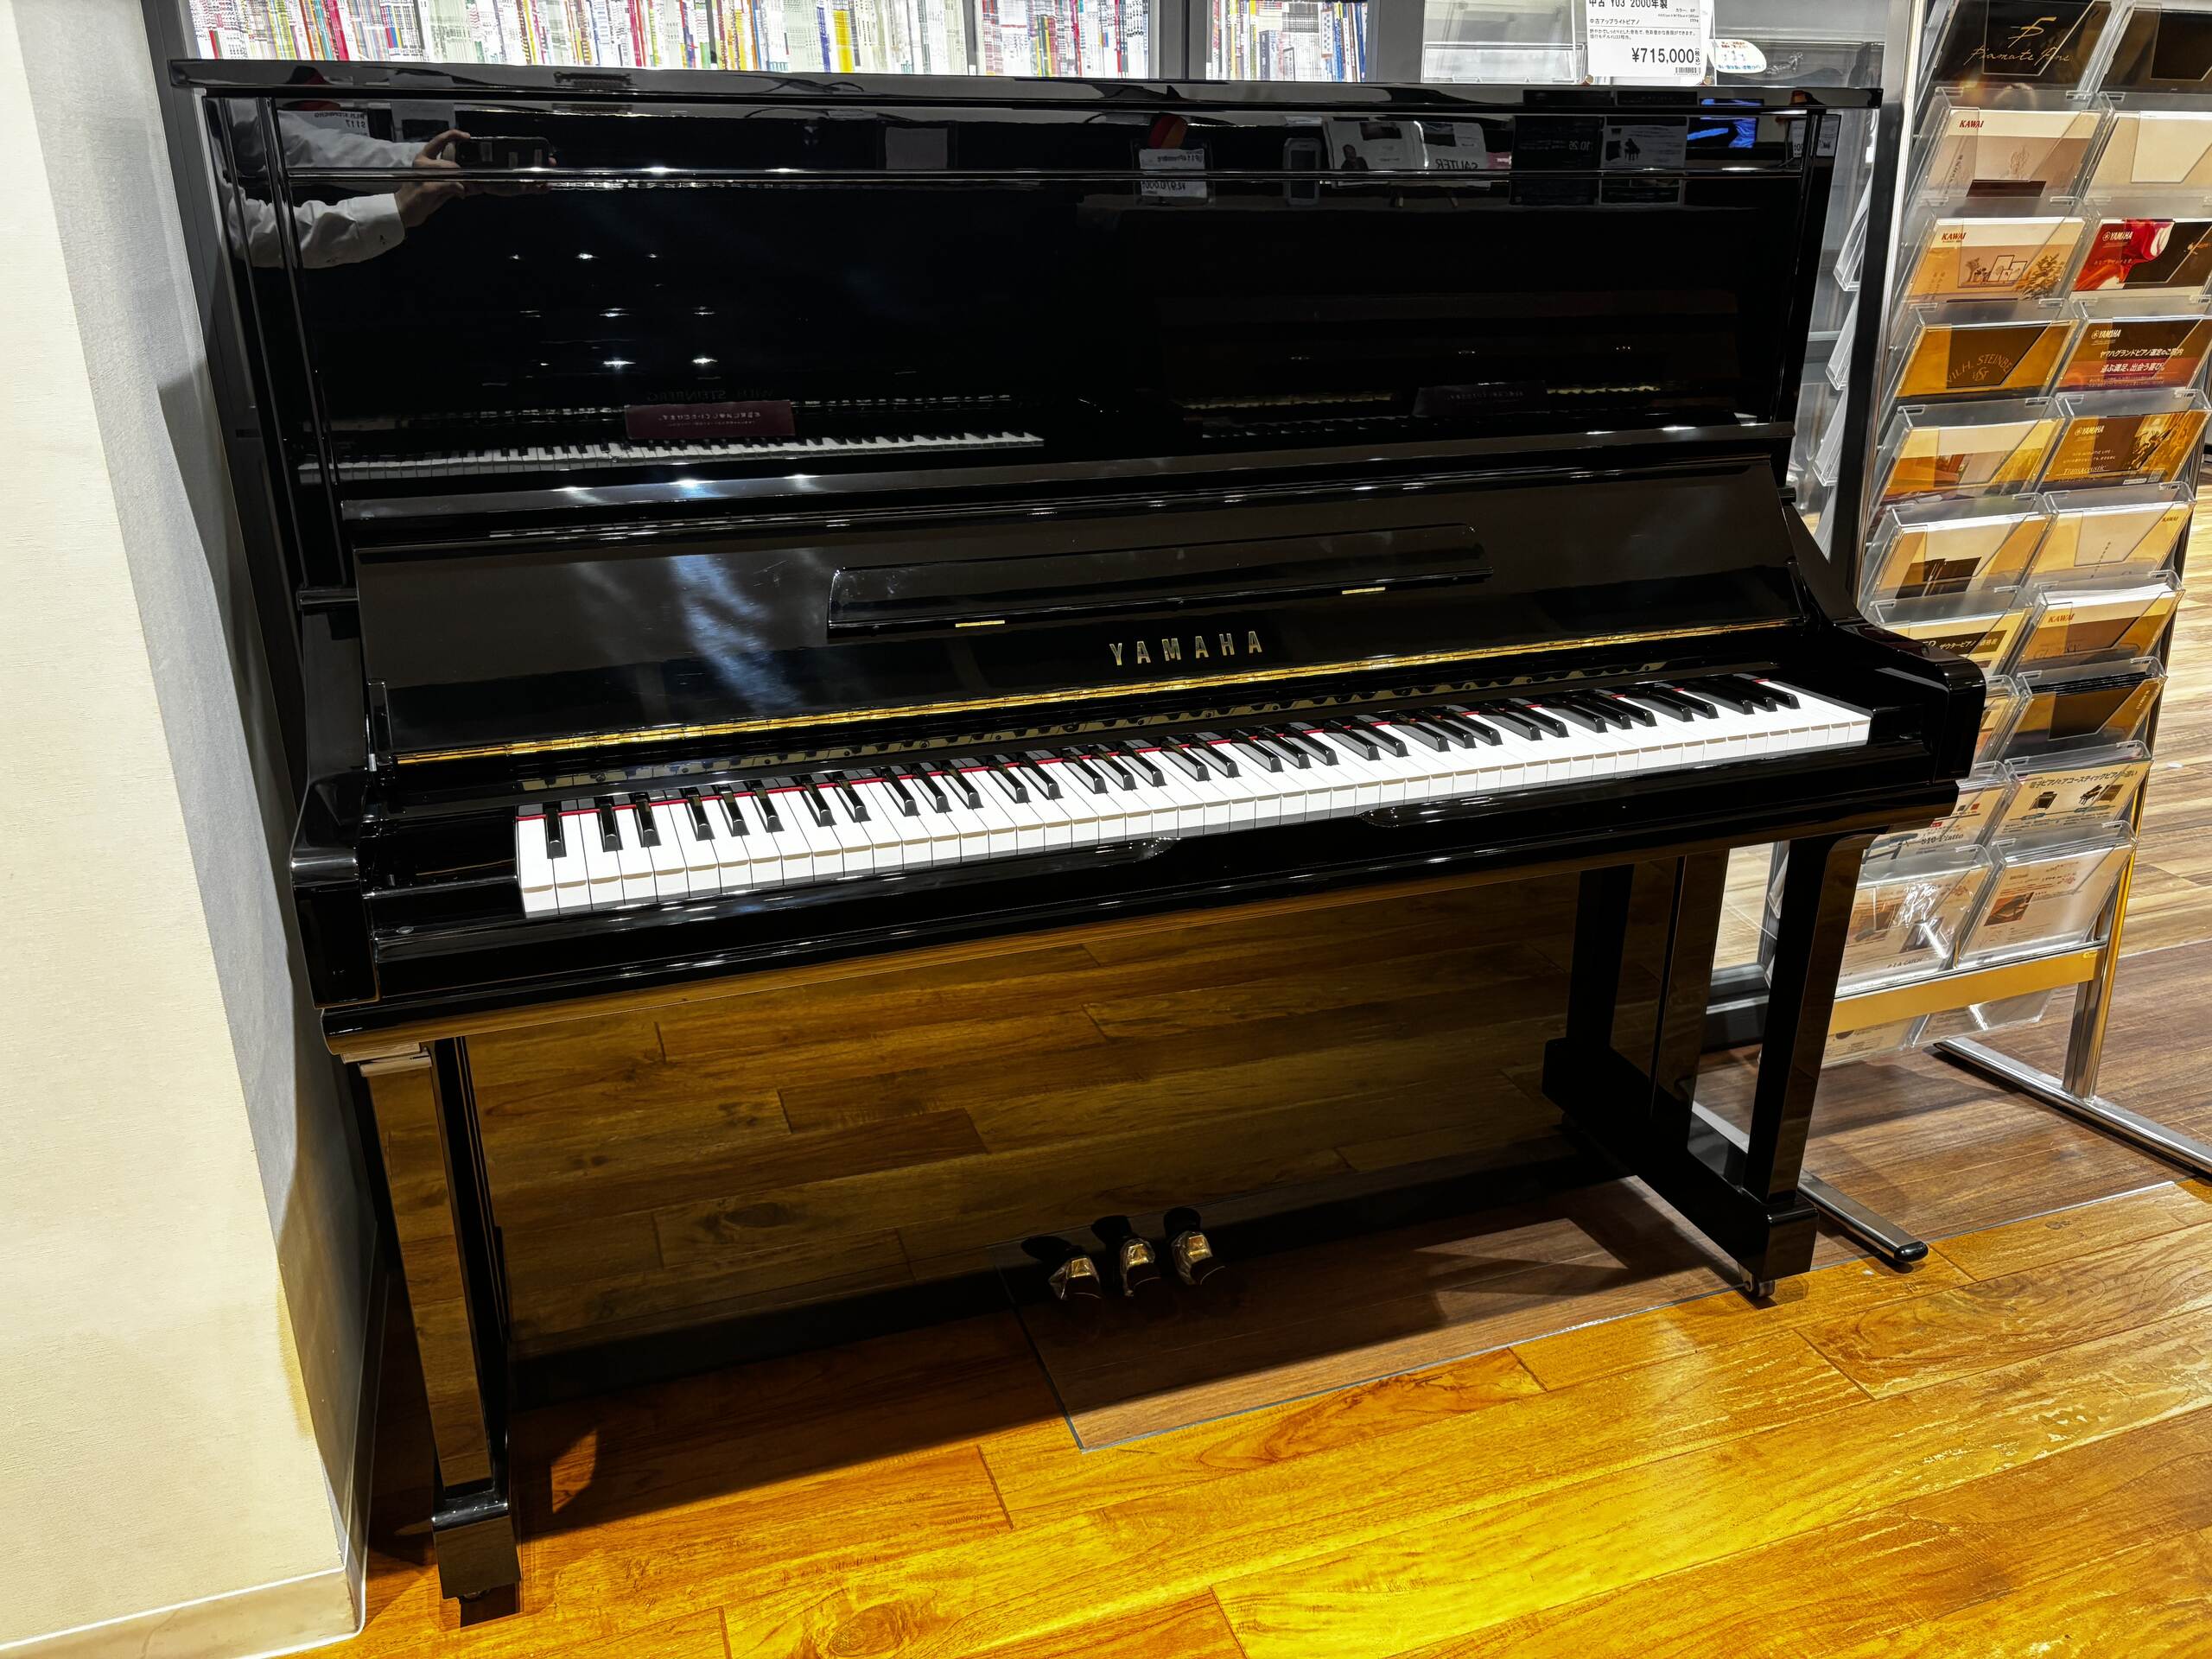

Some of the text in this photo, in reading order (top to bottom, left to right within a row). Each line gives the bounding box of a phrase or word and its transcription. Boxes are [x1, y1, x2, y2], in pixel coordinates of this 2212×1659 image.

[1631, 48, 1694, 64] ¥715,000
[1959, 120, 1984, 128] KAWAI
[1941, 232, 1967, 240] KAWAI
[2110, 231, 2134, 241] YAMAHA
[2098, 330, 2122, 339] YAMAHA
[2048, 613, 2075, 623] KAWAI
[1109, 631, 1262, 666] YAMAHA
